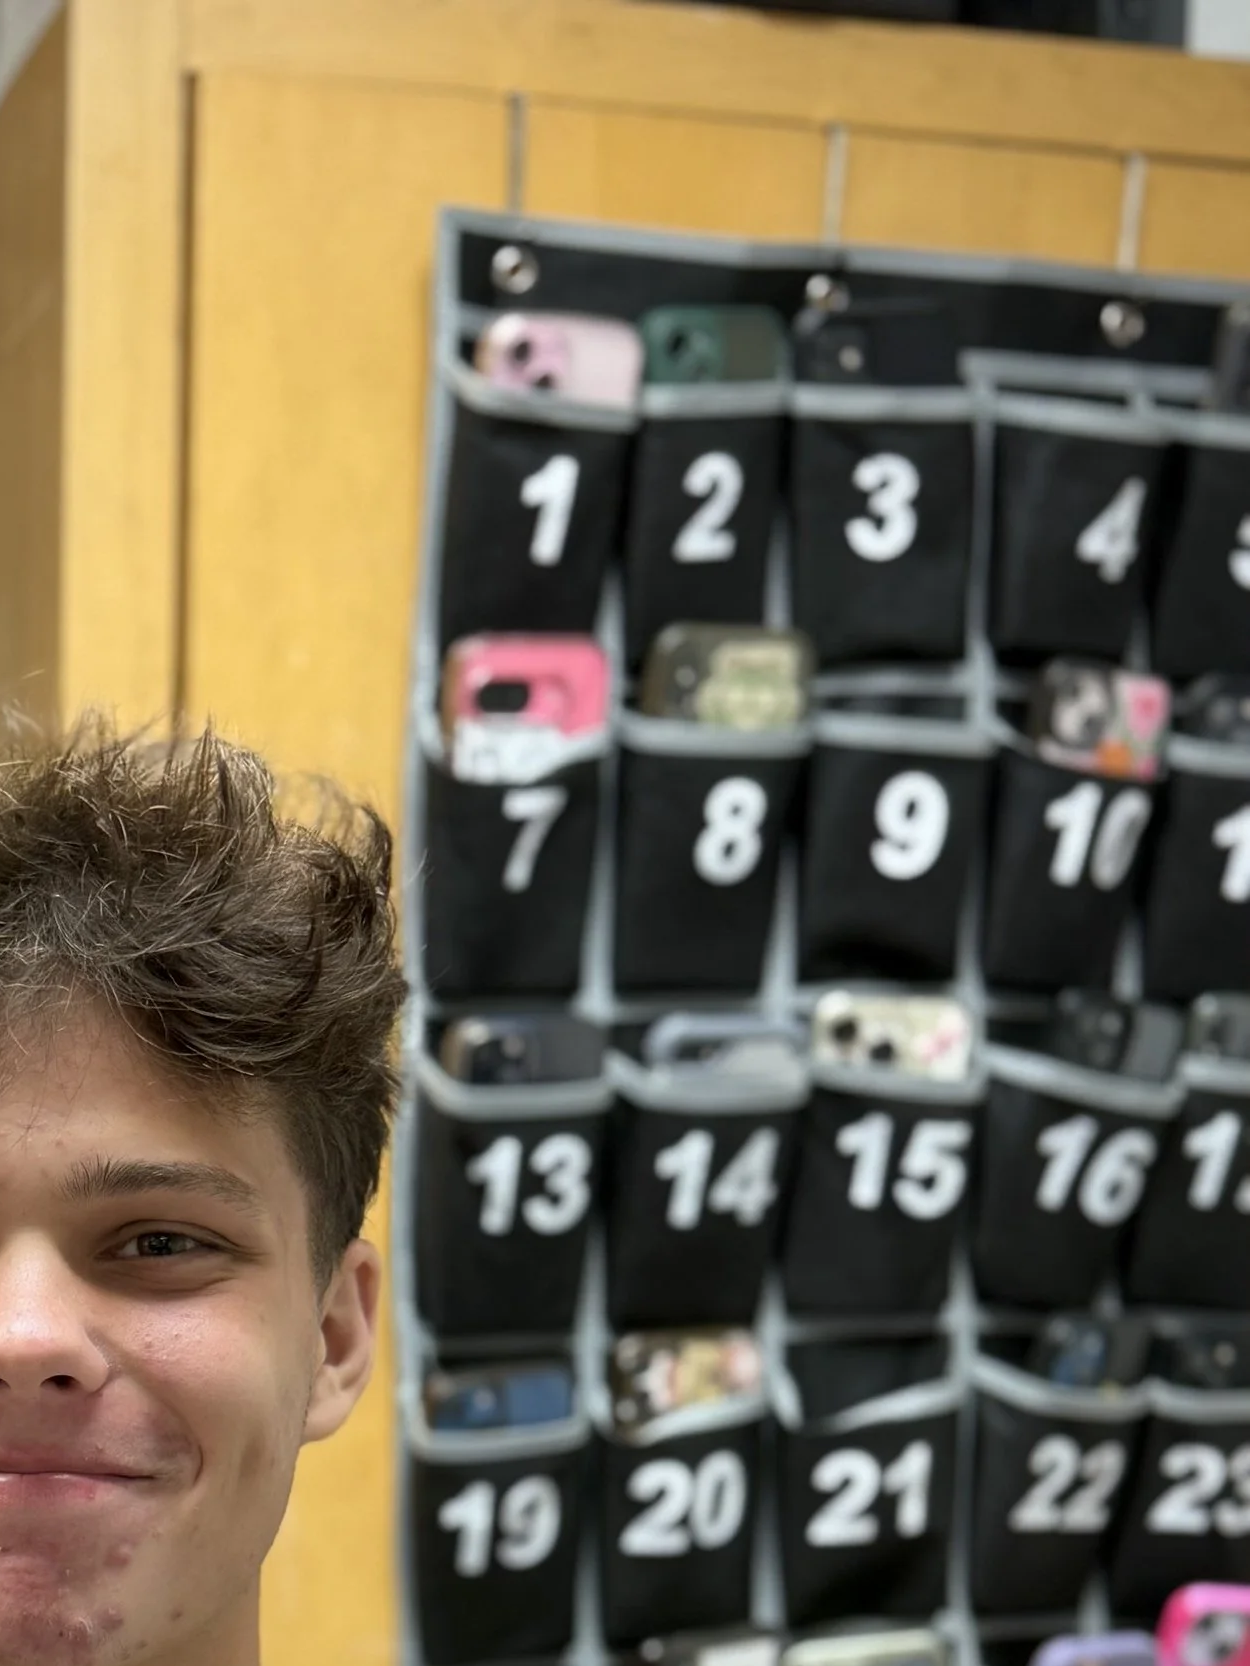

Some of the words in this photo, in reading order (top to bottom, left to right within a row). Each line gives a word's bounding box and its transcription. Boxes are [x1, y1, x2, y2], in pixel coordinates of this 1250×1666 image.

[519, 454, 580, 567] 1
[674, 452, 743, 562] 2
[845, 453, 919, 561] 3
[1077, 481, 1143, 580] 4
[502, 784, 568, 891] 7
[694, 777, 767, 883] 8
[871, 771, 949, 880] 9
[1045, 782, 1148, 886] 10
[470, 1134, 590, 1233] 13
[655, 1129, 777, 1228] 14
[837, 1113, 971, 1219] 15
[1036, 1115, 1155, 1225] 16
[1185, 1112, 1250, 1211] 1
[440, 1477, 560, 1574] 19
[619, 1450, 746, 1557] 20
[806, 1441, 932, 1546] 21
[1008, 1432, 1127, 1533] 22
